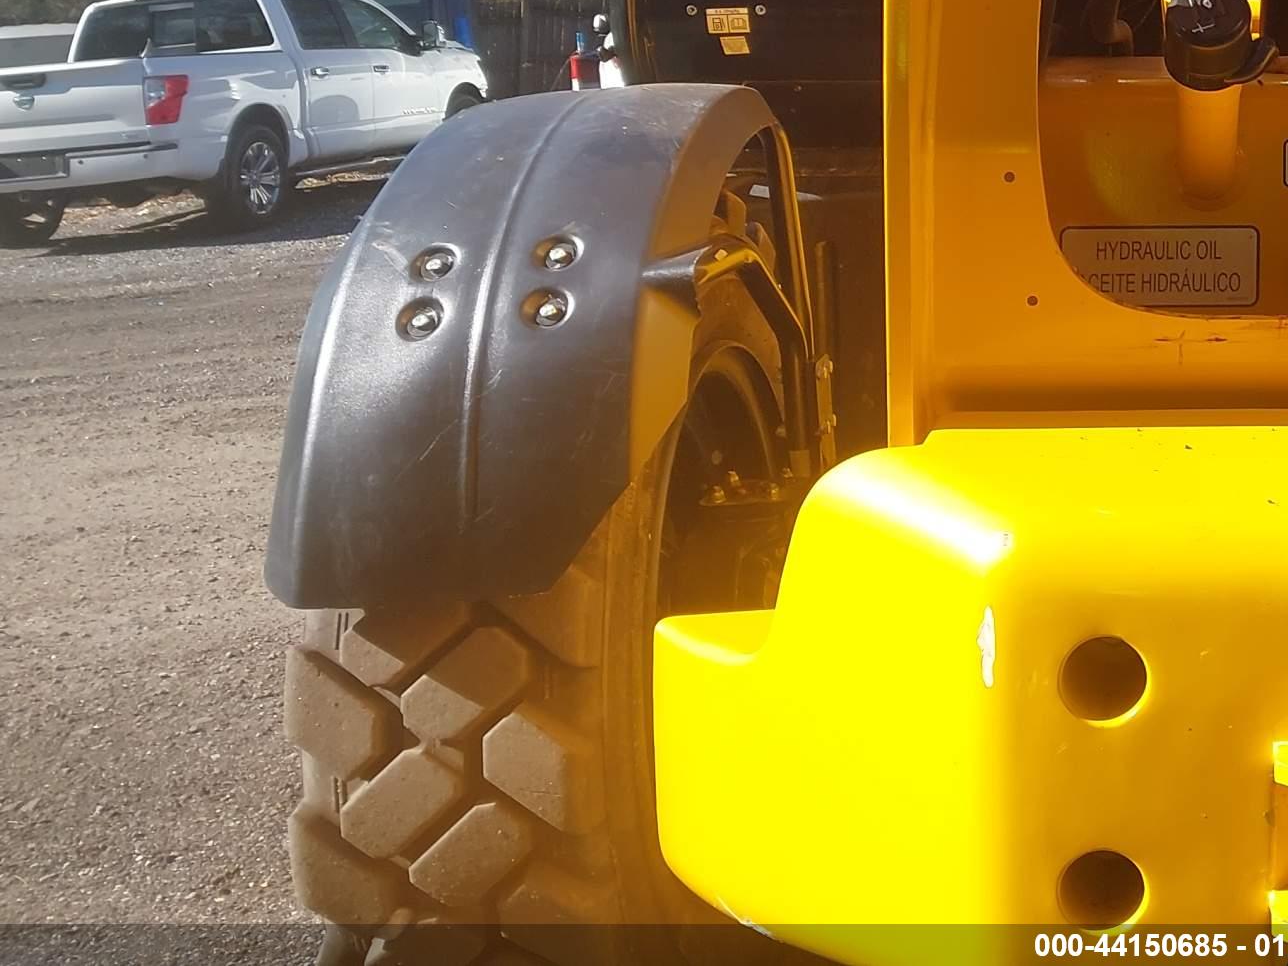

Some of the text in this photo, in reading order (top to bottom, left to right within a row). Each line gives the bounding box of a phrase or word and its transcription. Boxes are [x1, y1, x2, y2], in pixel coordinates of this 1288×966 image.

[1096, 240, 1223, 261] HYDRAULIC OIL
[1081, 267, 1242, 294] CEITE HIDRÁULICO
